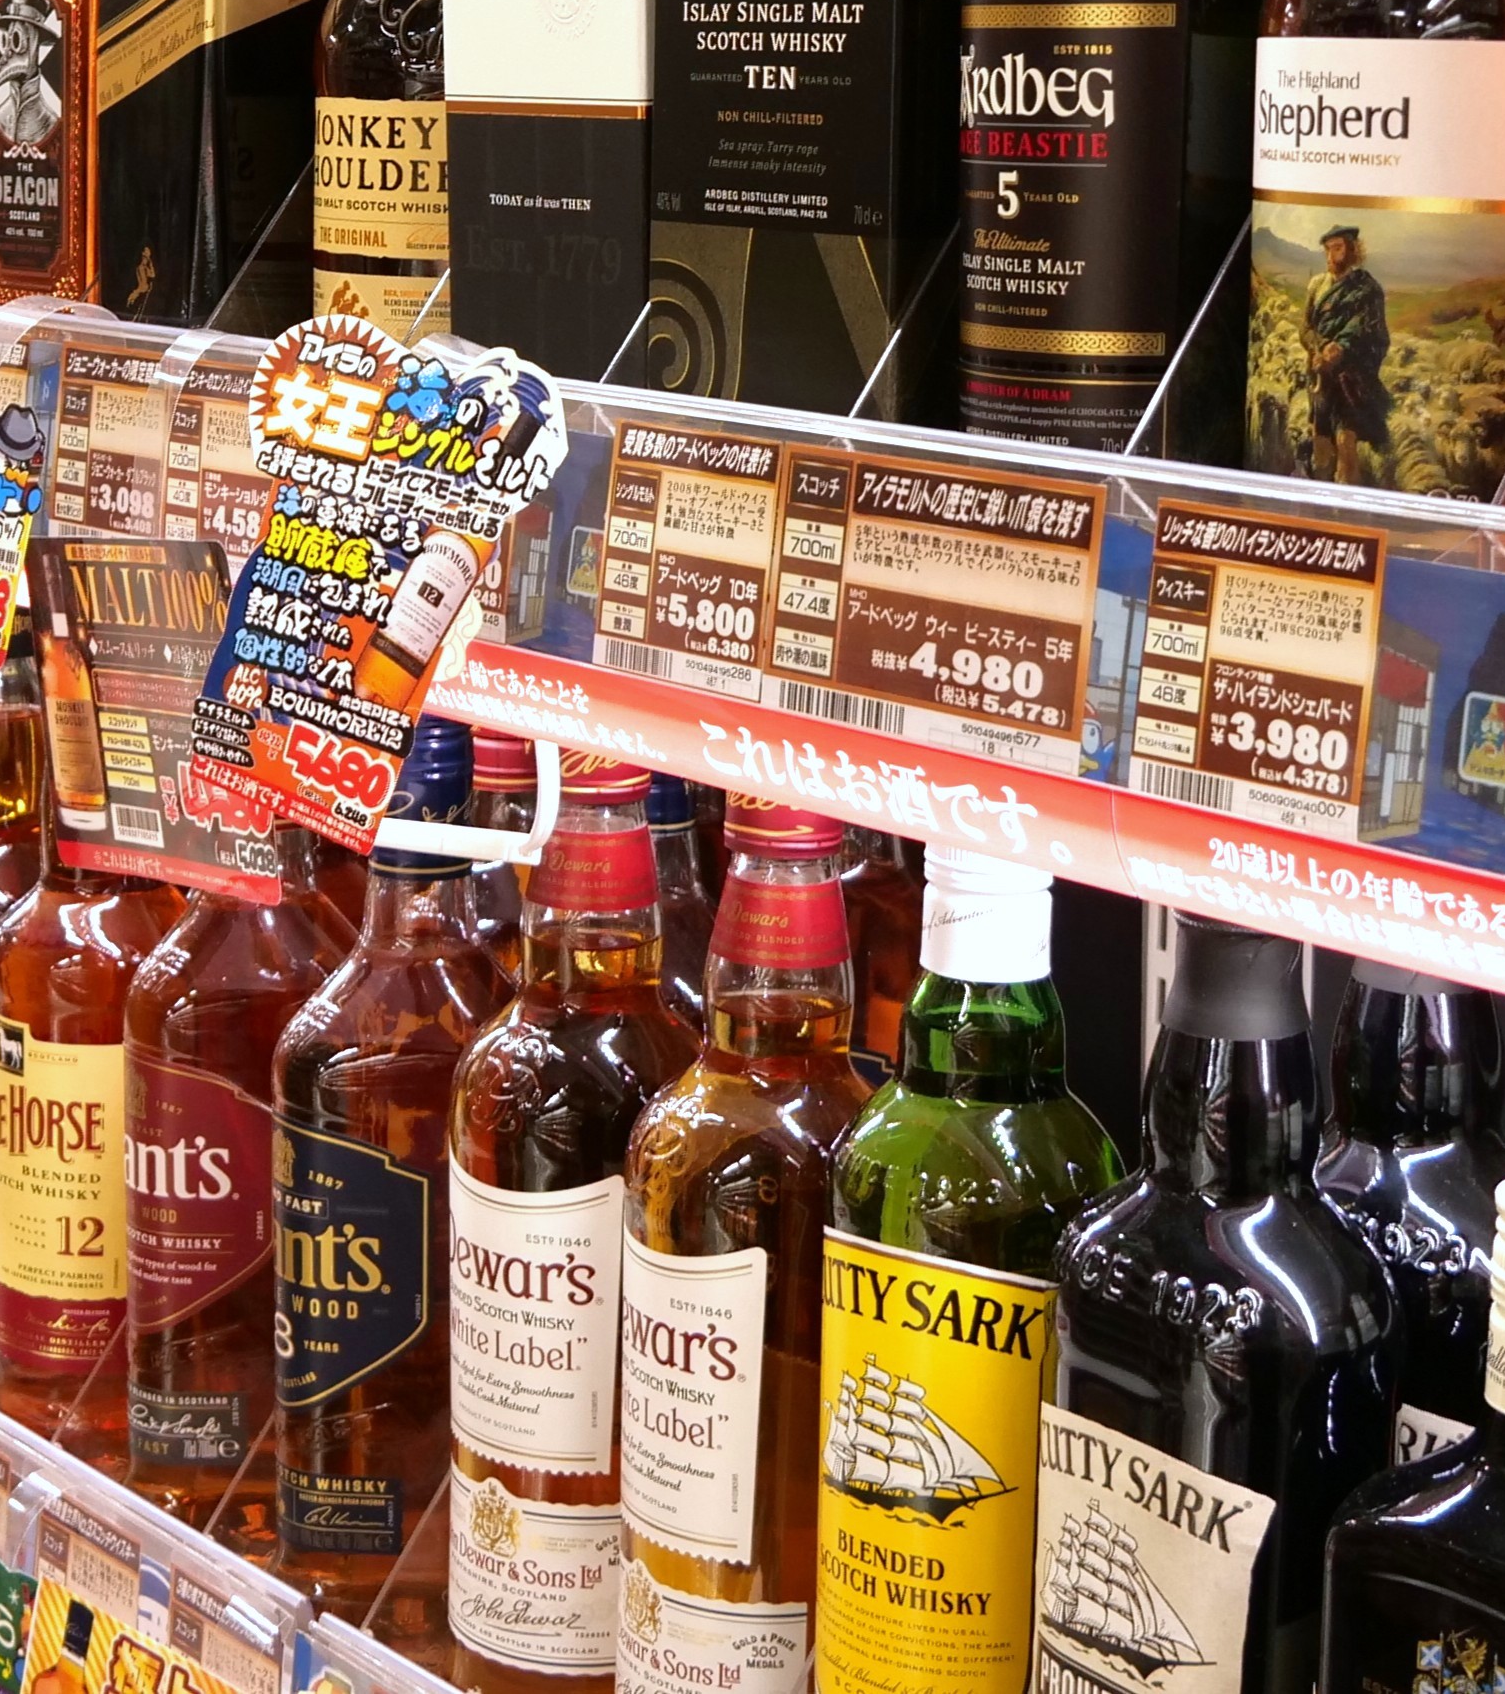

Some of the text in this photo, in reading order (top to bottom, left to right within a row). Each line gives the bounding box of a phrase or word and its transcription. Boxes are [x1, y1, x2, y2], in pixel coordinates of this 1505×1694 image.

[683, 1, 864, 24] ISLAY SINGLE MALT
[697, 31, 847, 53] SCOTCH WHISKY
[744, 65, 797, 90] TEN
[1277, 70, 1361, 94] The Highland
[742, 111, 824, 126] CHILL-FILTERED
[1258, 90, 1411, 147] Shepherd
[987, 132, 1109, 159] BEASTIE
[16, 163, 33, 172] THE
[1302, 150, 1346, 166] SCOTCH
[346, 199, 397, 212] SCOTCH
[741, 190, 828, 206] DISTILLERY LIMITED
[997, 171, 1020, 218] 5
[9, 210, 40, 222] SCOTLAND
[334, 227, 388, 248] ORIGINAL
[984, 256, 1085, 276] SINGLE MALT
[1005, 277, 1069, 296] WHISKY
[299, 332, 377, 379] アイラの
[263, 373, 383, 461] 女王
[257, 445, 357, 496] と評される
[798, 471, 841, 496] スコッチ
[612, 529, 649, 549] 700ml
[789, 537, 836, 560] 700ml
[1161, 516, 1366, 572] リッチな香りのハイランドシングルモルト
[729, 577, 758, 602] 10年
[1156, 578, 1205, 602] ウィスキー
[784, 590, 830, 617] 47.4度
[1045, 637, 1073, 662] 5年
[1152, 633, 1200, 657] 700ml
[1152, 685, 1187, 706] 46度
[192, 754, 286, 812] これはお酒です。
[698, 719, 1073, 866] これはお酒です。
[9, 1083, 105, 1164] HORSE
[20, 1164, 102, 1186] BLENDED
[307, 1169, 344, 1191] 1887
[29, 1182, 102, 1203] WHISKY
[54, 1216, 106, 1259] 12
[161, 1235, 222, 1251] WHISKY
[558, 1237, 591, 1248] 1846
[291, 1293, 359, 1321] WOOD
[521, 1311, 575, 1331] WHISKY
[900, 1278, 1044, 1361] SARK
[303, 1340, 339, 1355] YEARS
[665, 1379, 715, 1406] WHISKY
[315, 1478, 387, 1496] WHISKY
[1127, 1457, 1245, 1554] SARK
[836, 1528, 945, 1583] BLENDED
[885, 1576, 993, 1617] WHISKY
